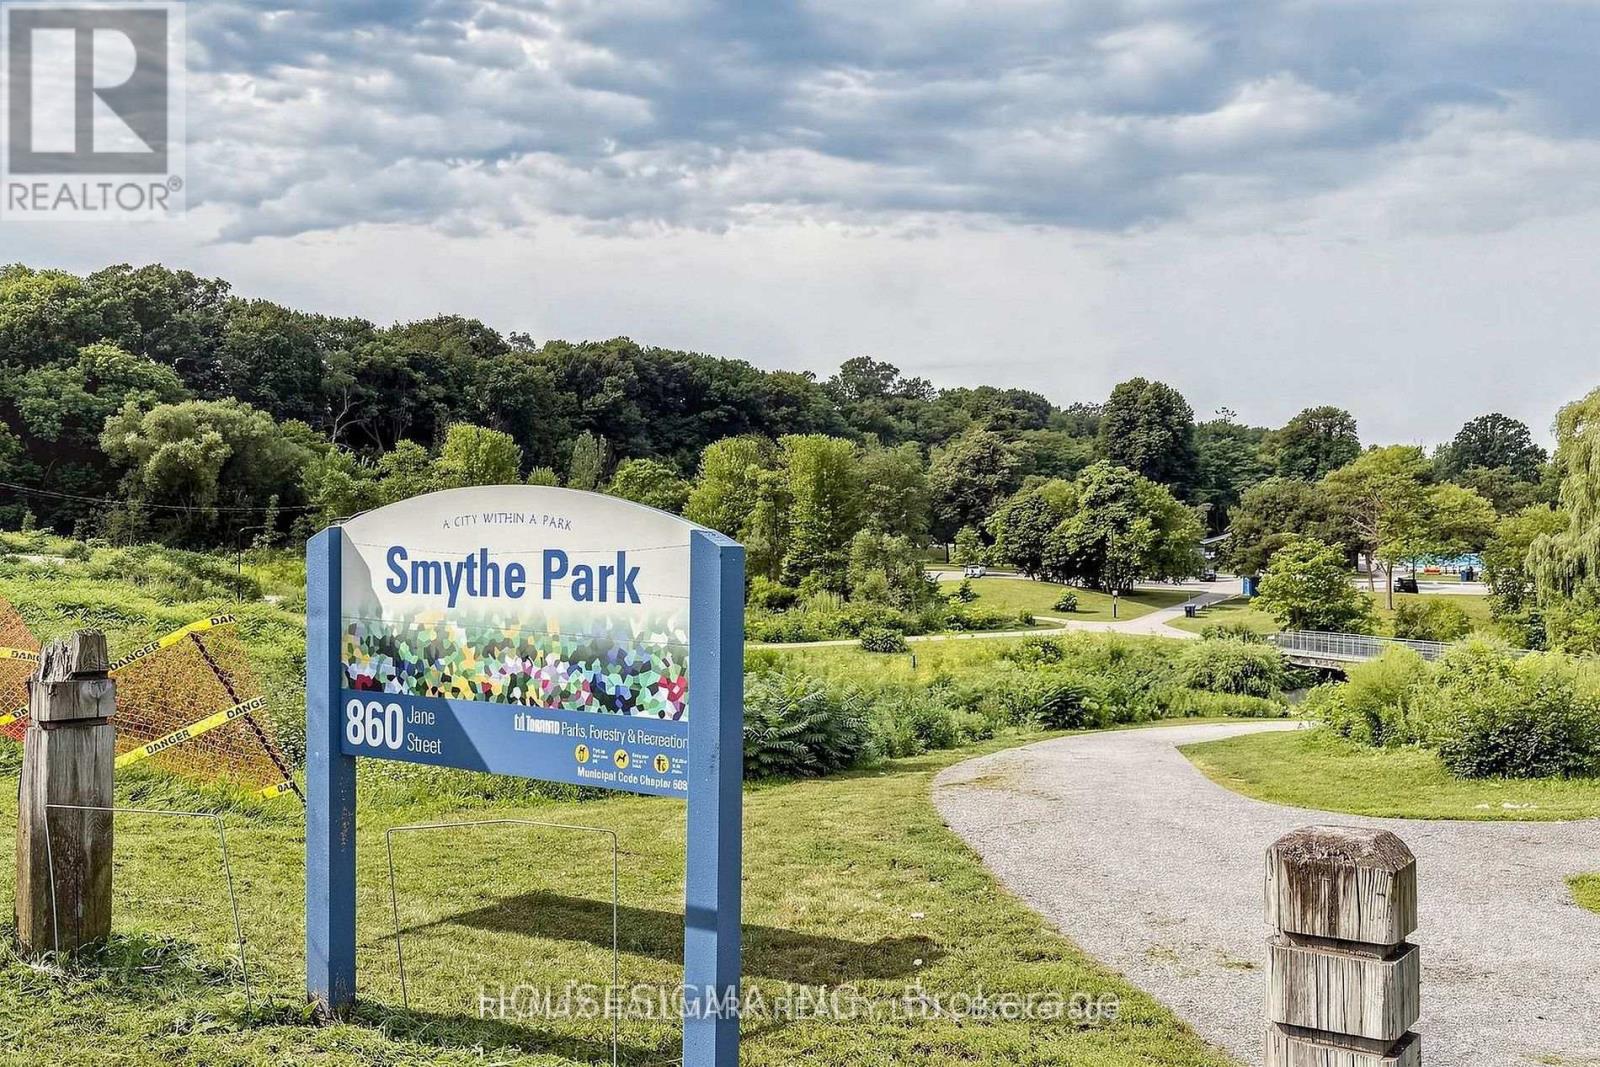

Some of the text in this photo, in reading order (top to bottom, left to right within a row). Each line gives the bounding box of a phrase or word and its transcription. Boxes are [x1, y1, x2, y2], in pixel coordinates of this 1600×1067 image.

[443, 512, 573, 531] A CITY WITHIN A PARK
[386, 545, 642, 608] Smythe Park
[109, 640, 161, 672] DANGER
[346, 698, 404, 750] 860
[406, 705, 436, 726] Jane
[145, 729, 191, 755] DANGER
[406, 732, 442, 755] Street
[561, 721, 588, 740] Parks,
[589, 724, 626, 746] Forestry
[627, 728, 636, 744] &
[637, 729, 689, 749] Recreation
[577, 766, 617, 783] Municipal
[618, 771, 639, 784] Code
[639, 774, 671, 788] Chapter
